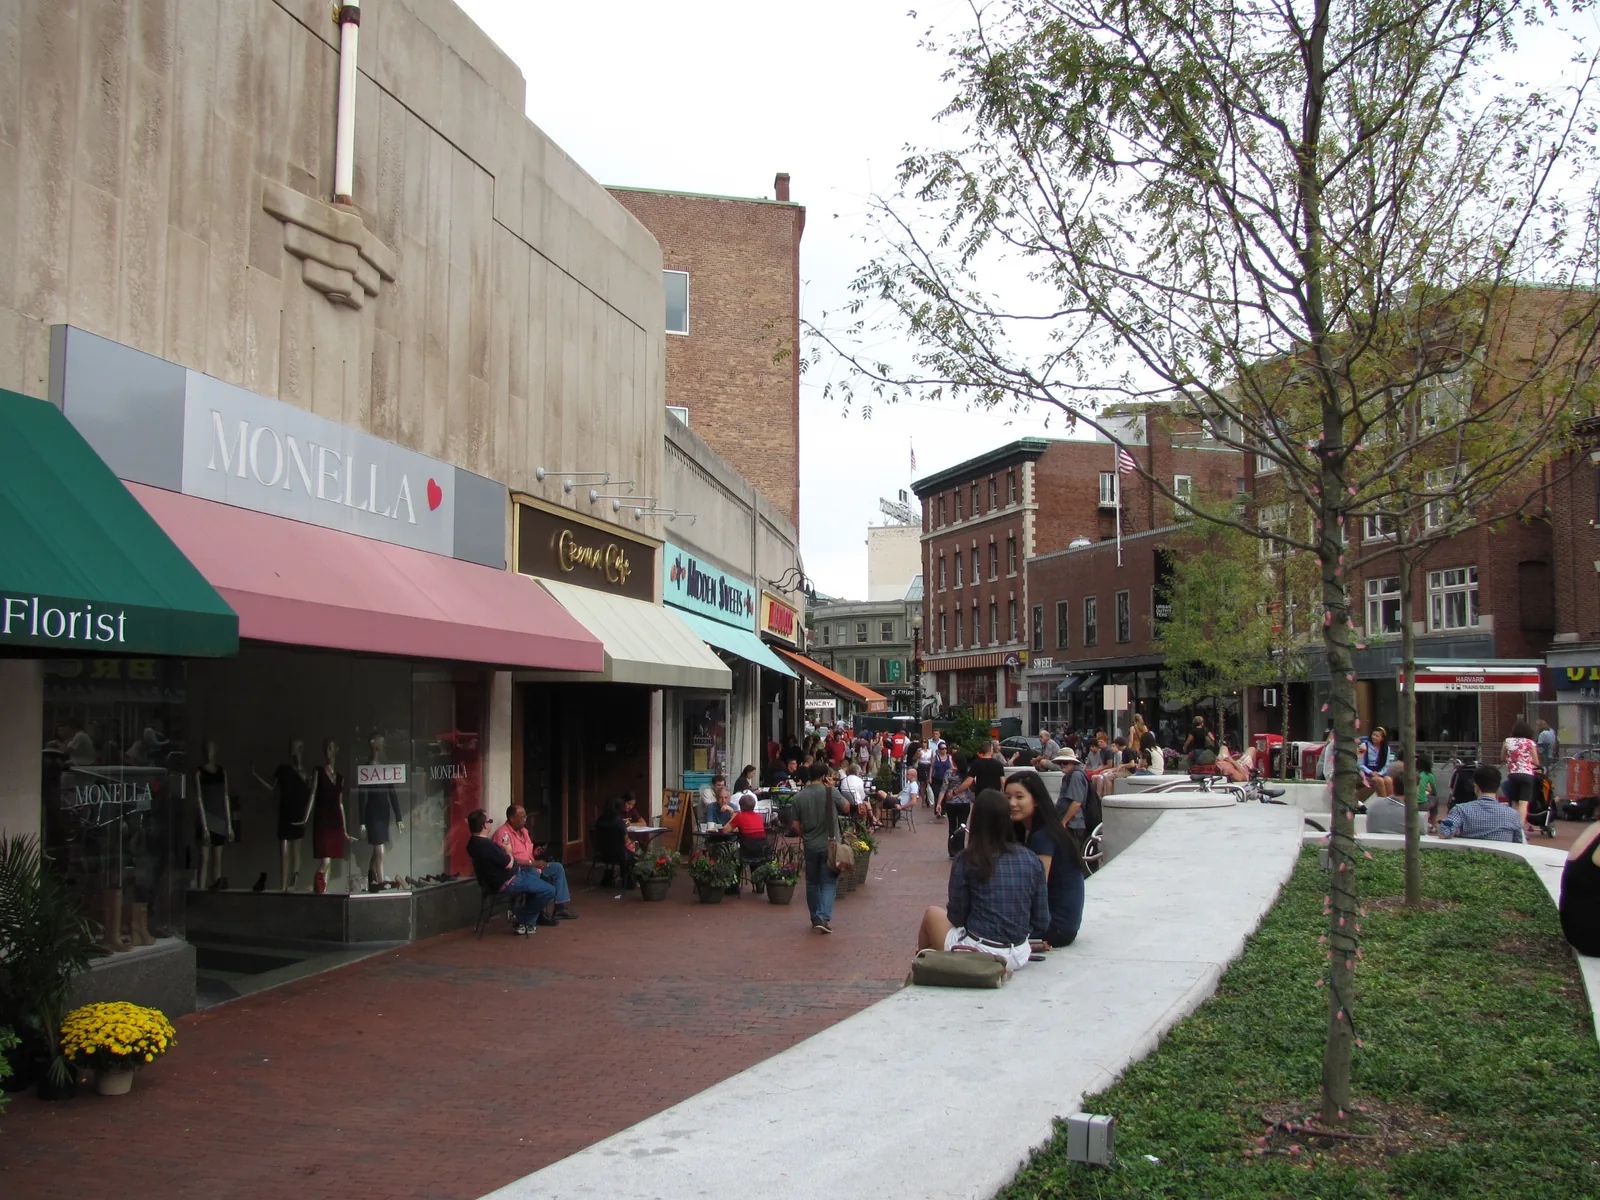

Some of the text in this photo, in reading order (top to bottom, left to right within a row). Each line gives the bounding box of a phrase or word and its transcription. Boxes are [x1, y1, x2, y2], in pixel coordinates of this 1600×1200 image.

[206, 408, 418, 525] MONELLA
[687, 558, 743, 617] HIDDEN SWEETS
[2, 596, 127, 643] Florist
[1034, 657, 1054, 668] SWEET
[359, 766, 403, 782] SALE
[429, 764, 468, 780] MONELLA
[75, 781, 153, 807] MONELLA
